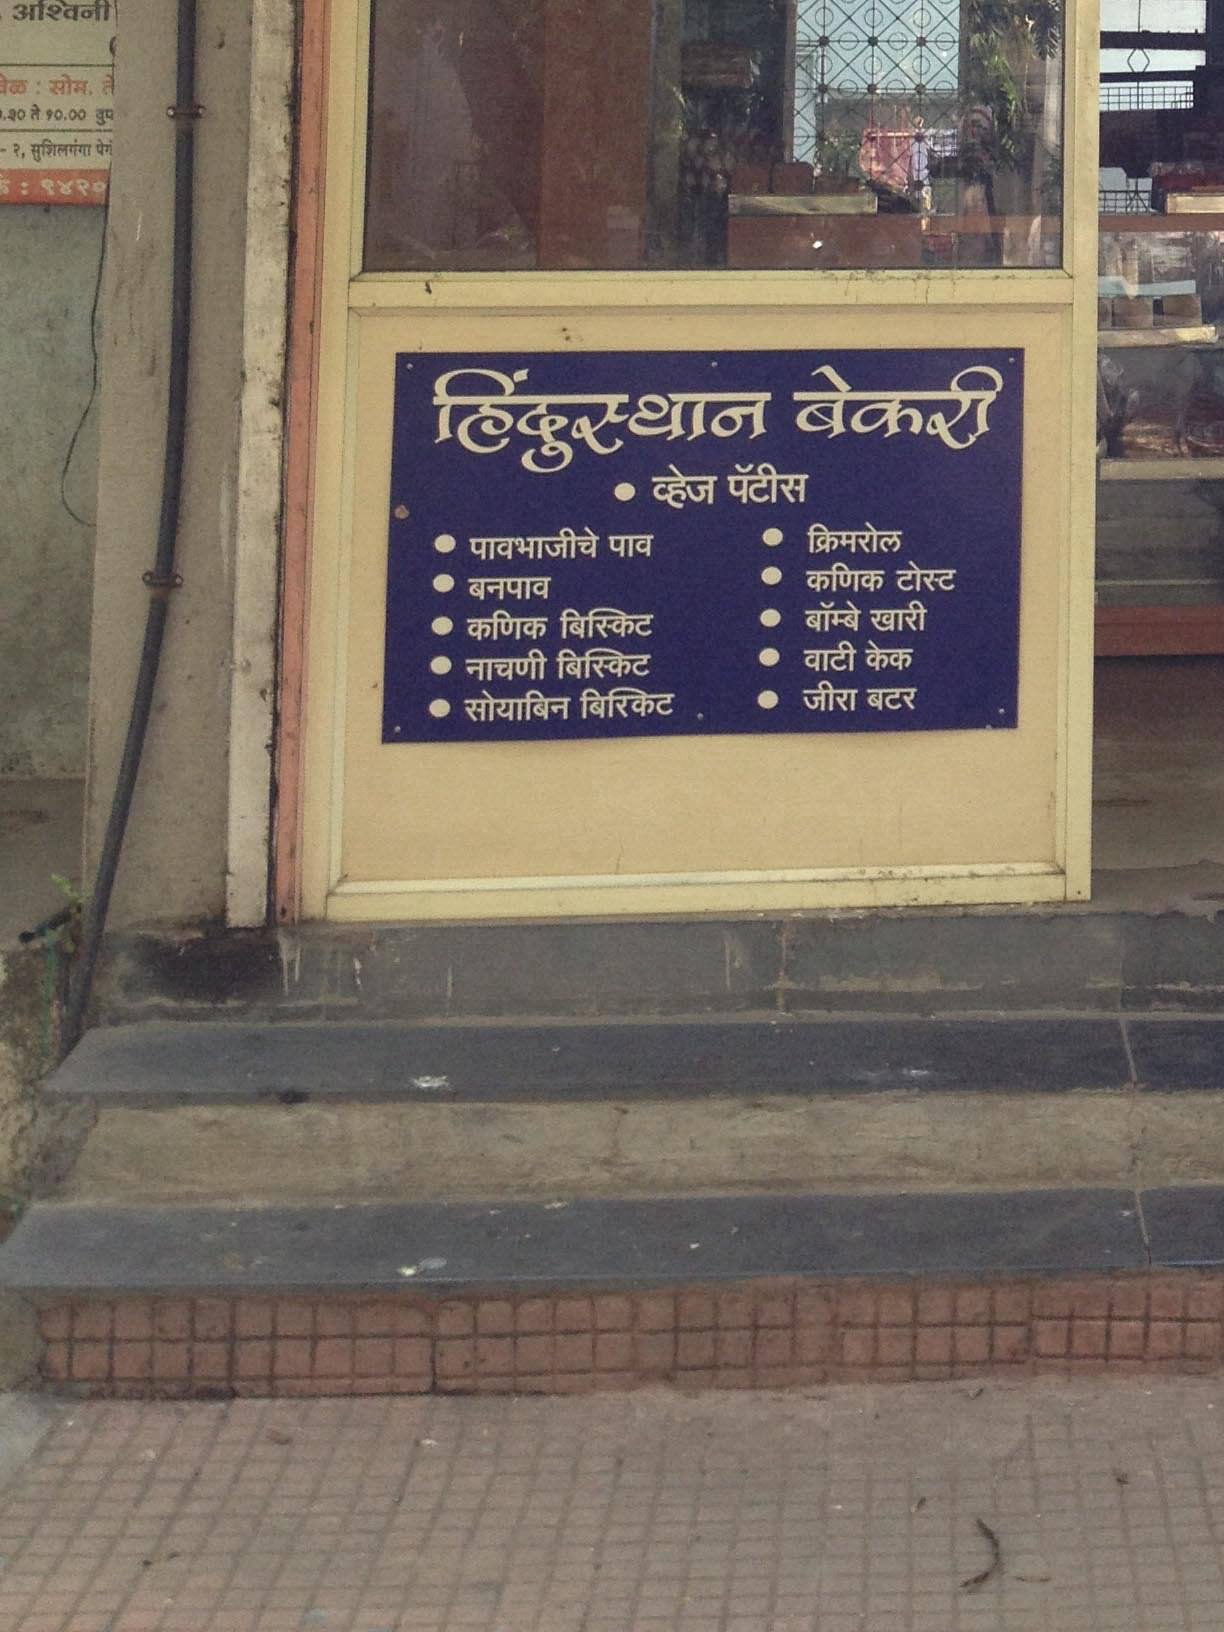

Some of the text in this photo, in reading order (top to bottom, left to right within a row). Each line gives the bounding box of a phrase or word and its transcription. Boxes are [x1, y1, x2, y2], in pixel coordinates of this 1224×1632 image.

[433, 365, 1004, 473] हिंदुस्थान बेकरी
[652, 464, 809, 509] व्हेज पॅटीस
[469, 527, 655, 560] पावभाजीचे पाव
[807, 522, 903, 554] क्रिमरोल
[467, 577, 552, 600] बनपाव
[806, 560, 957, 592] कणिक टोस्ट
[466, 607, 655, 641] कणिक बिस्किट
[804, 600, 928, 632] बॉम्बे खारी
[465, 647, 652, 681] नाचणी बिस्किट
[803, 639, 914, 672] वाटी केक
[464, 689, 571, 722] सोयाबिन
[803, 680, 917, 712] जीरा बटर
